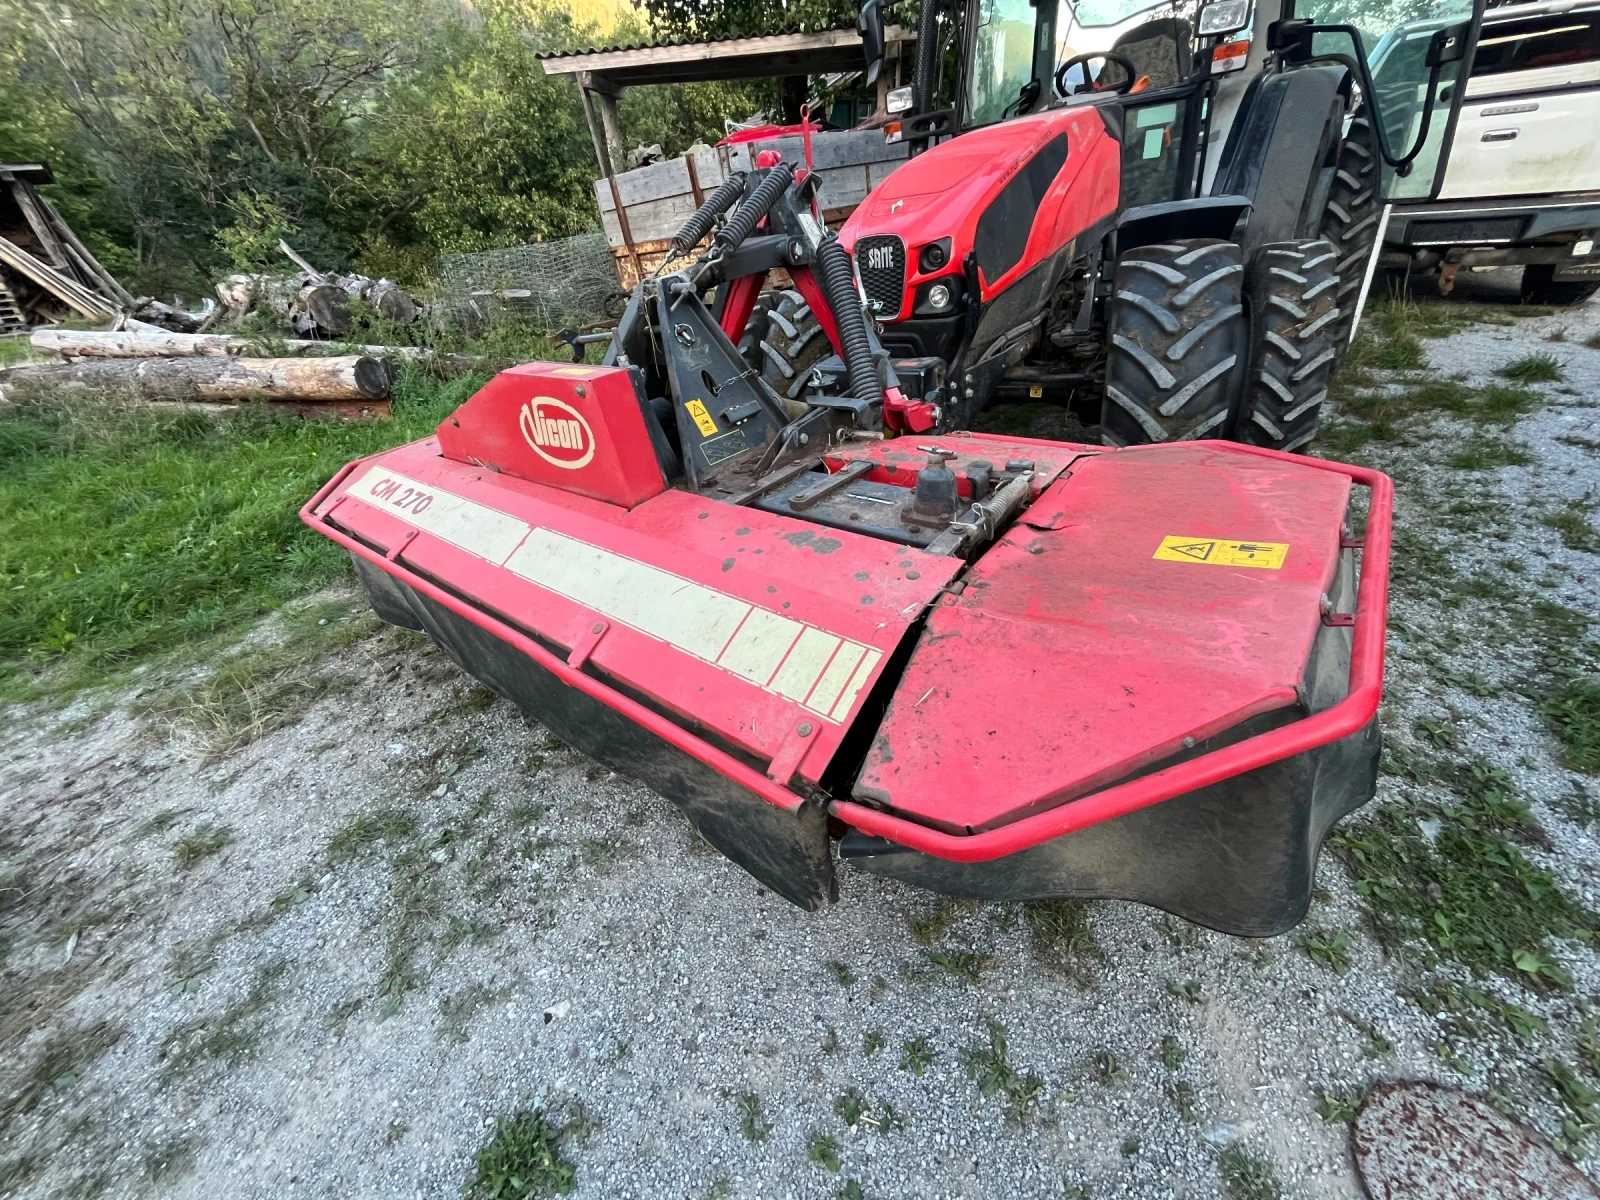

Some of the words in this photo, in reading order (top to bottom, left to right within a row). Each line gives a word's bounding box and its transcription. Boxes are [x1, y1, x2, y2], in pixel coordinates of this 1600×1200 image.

[868, 246, 894, 269] SAME
[520, 397, 584, 450] Vicon
[370, 478, 403, 501] CM
[392, 487, 434, 515] 270
